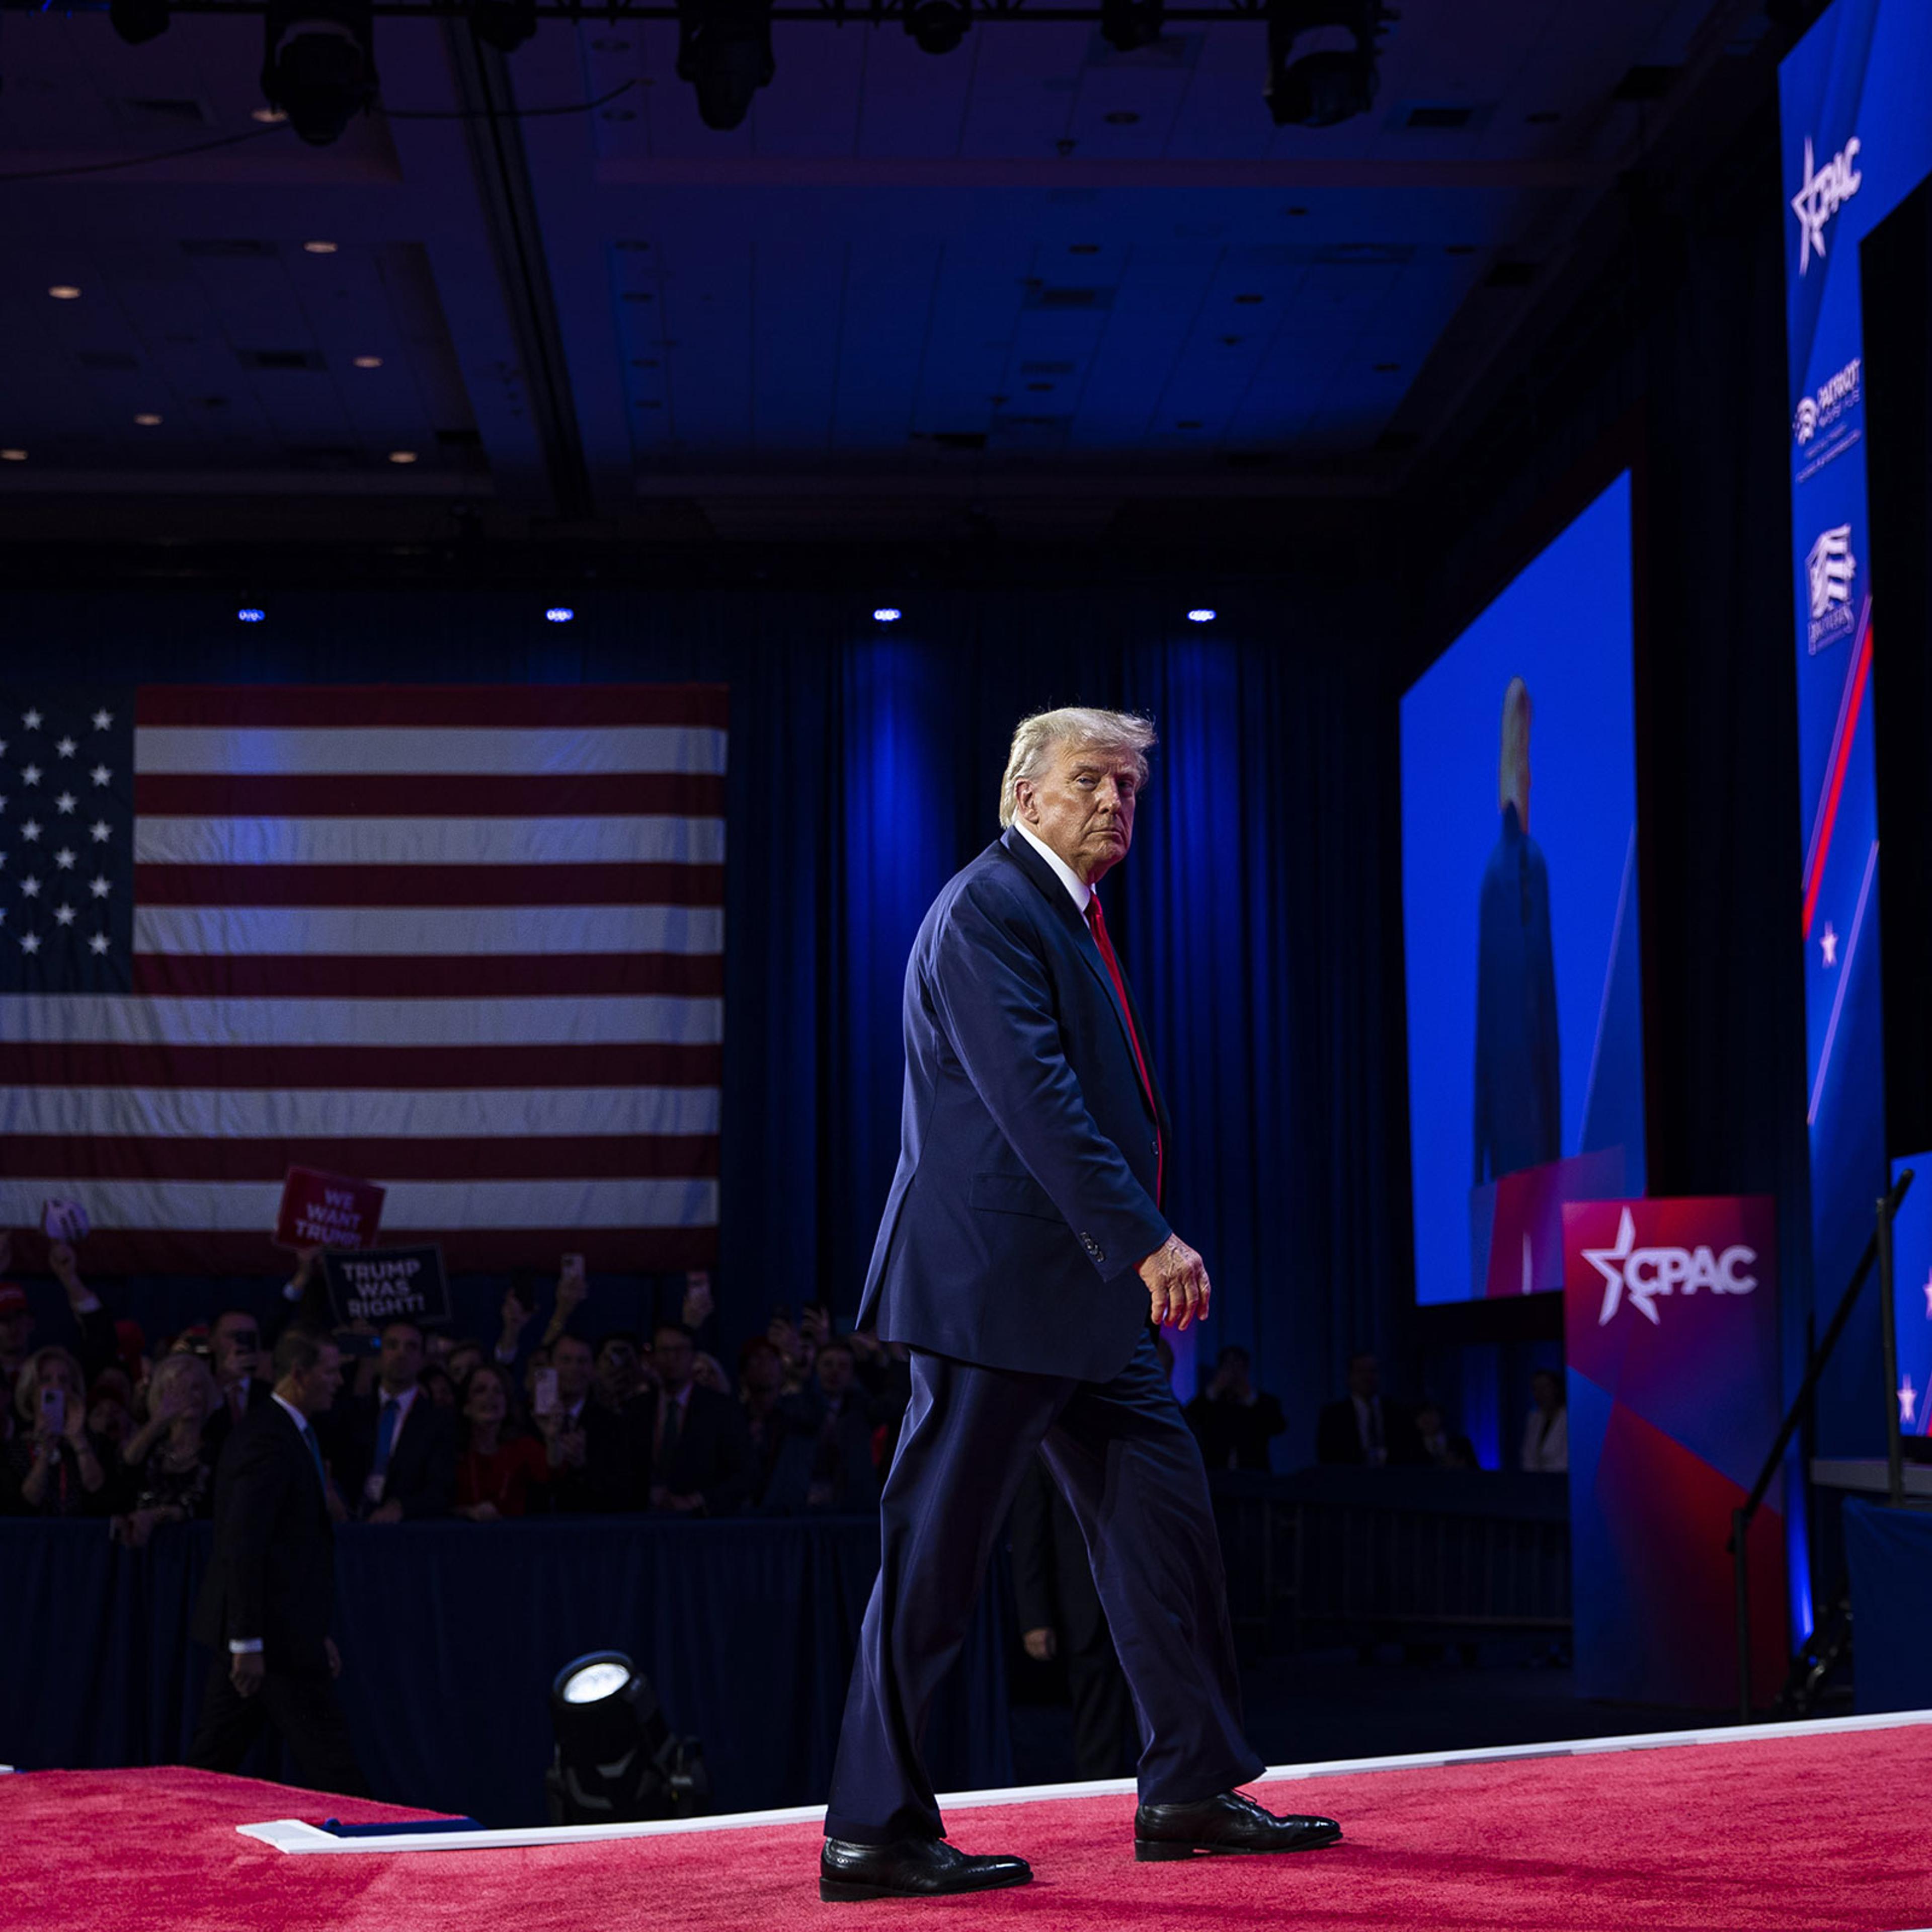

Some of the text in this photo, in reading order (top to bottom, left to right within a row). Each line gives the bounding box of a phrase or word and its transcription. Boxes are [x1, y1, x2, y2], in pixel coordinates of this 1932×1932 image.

[325, 1188, 354, 1210] WE
[306, 1202, 362, 1230] WANT
[342, 1259, 421, 1281] TRUMP
[1623, 1245, 1758, 1295] CPAC
[355, 1278, 410, 1298] WAS
[348, 1294, 426, 1318] RIGHT!
